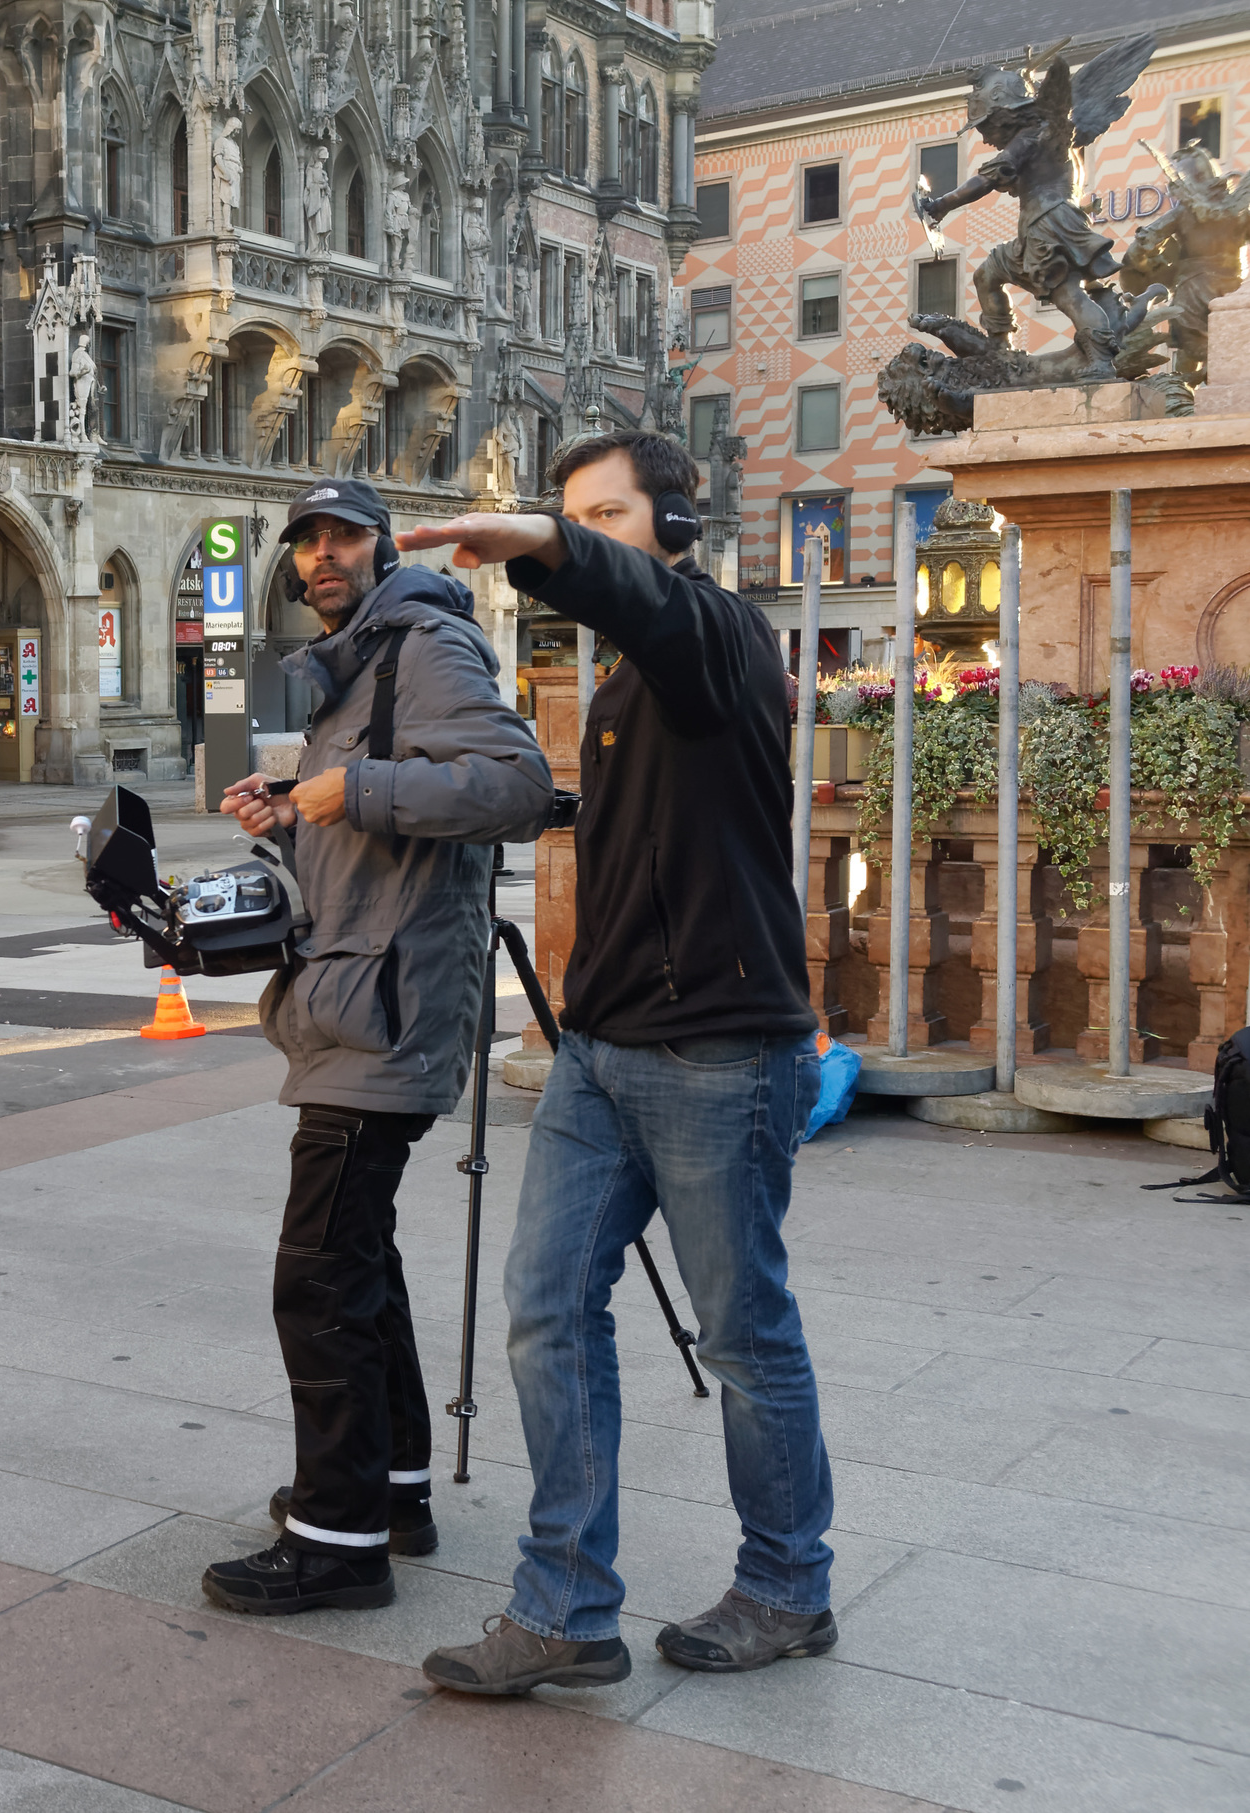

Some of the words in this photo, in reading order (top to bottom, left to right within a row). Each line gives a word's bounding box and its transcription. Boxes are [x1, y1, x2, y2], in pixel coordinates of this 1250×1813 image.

[211, 523, 236, 560] S
[178, 574, 203, 591] atsk
[211, 571, 235, 607] U
[205, 621, 243, 630] Marienplatz
[211, 642, 237, 652] 08:04
